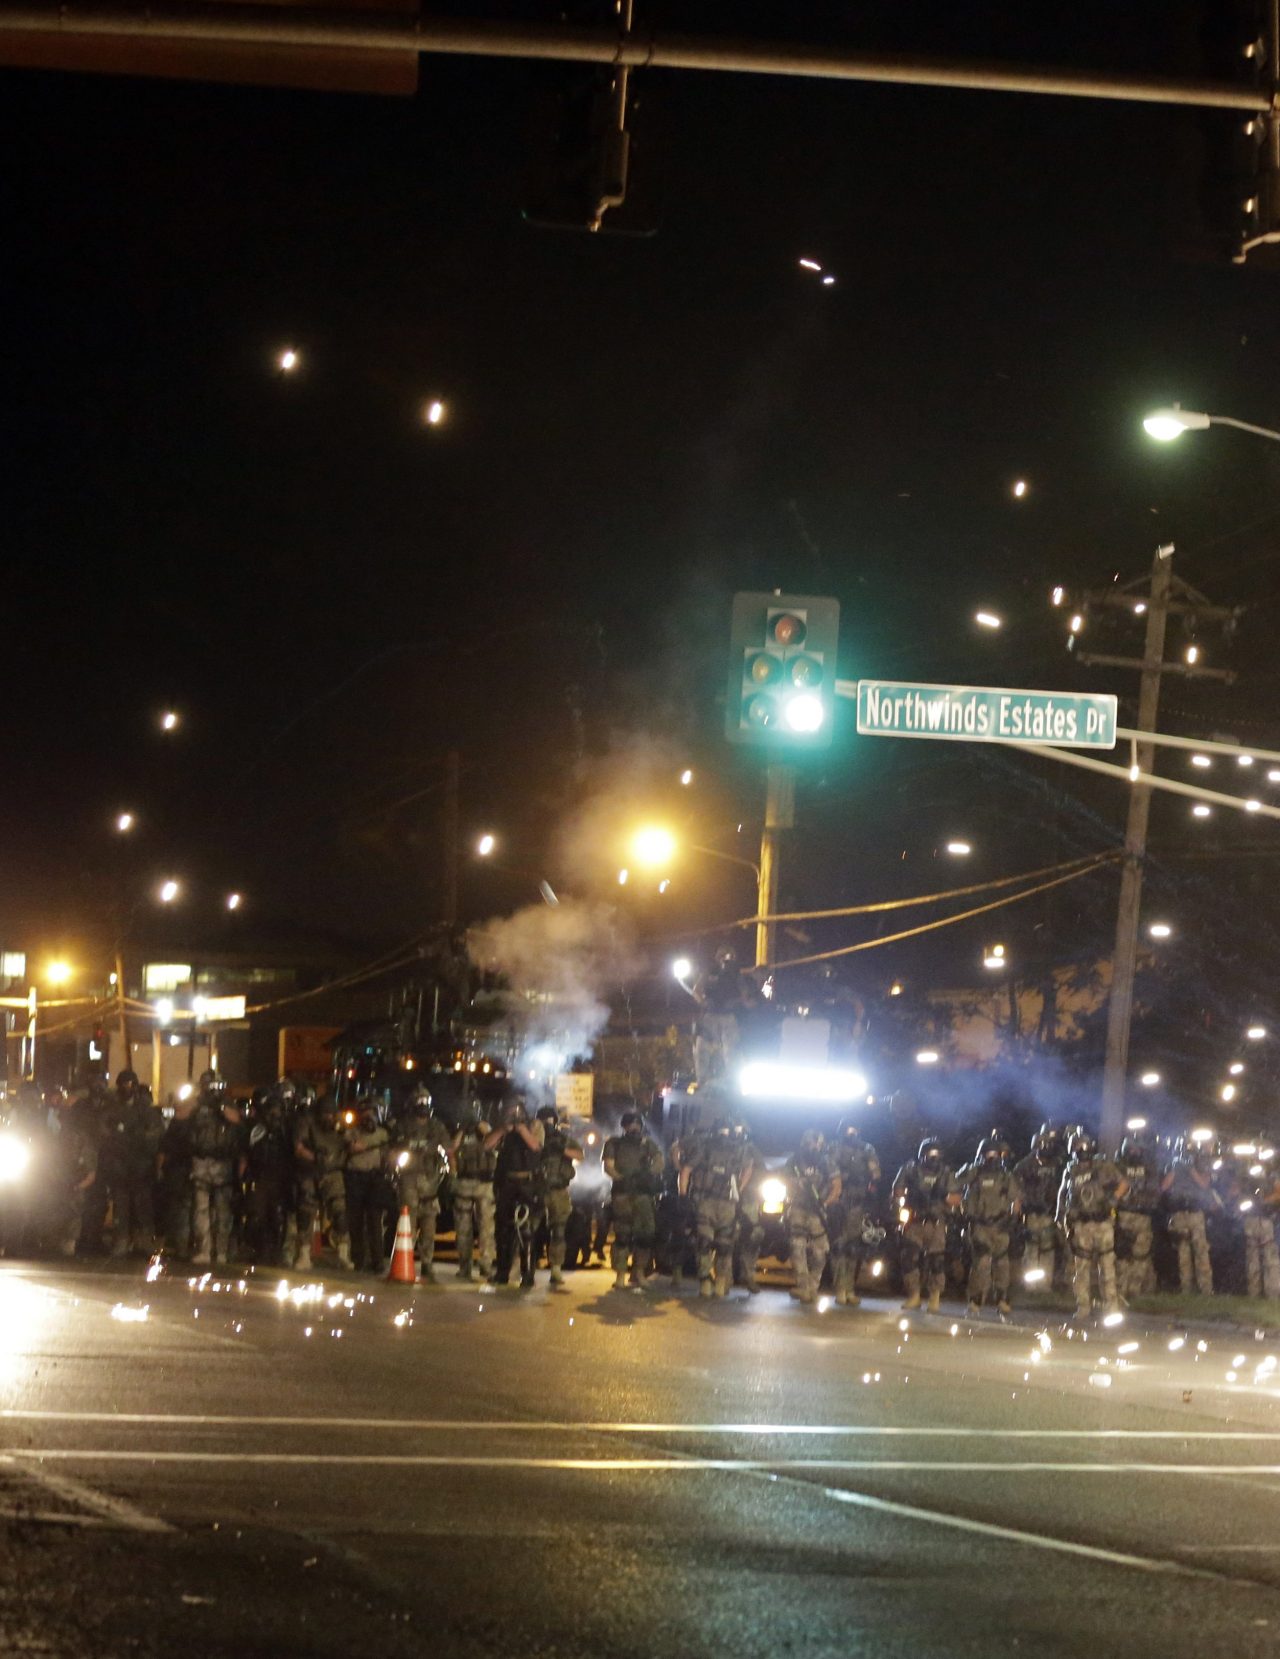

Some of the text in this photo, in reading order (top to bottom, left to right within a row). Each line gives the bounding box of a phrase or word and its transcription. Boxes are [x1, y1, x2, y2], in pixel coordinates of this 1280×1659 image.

[866, 688, 1107, 739] Northwinds Estates Dr
